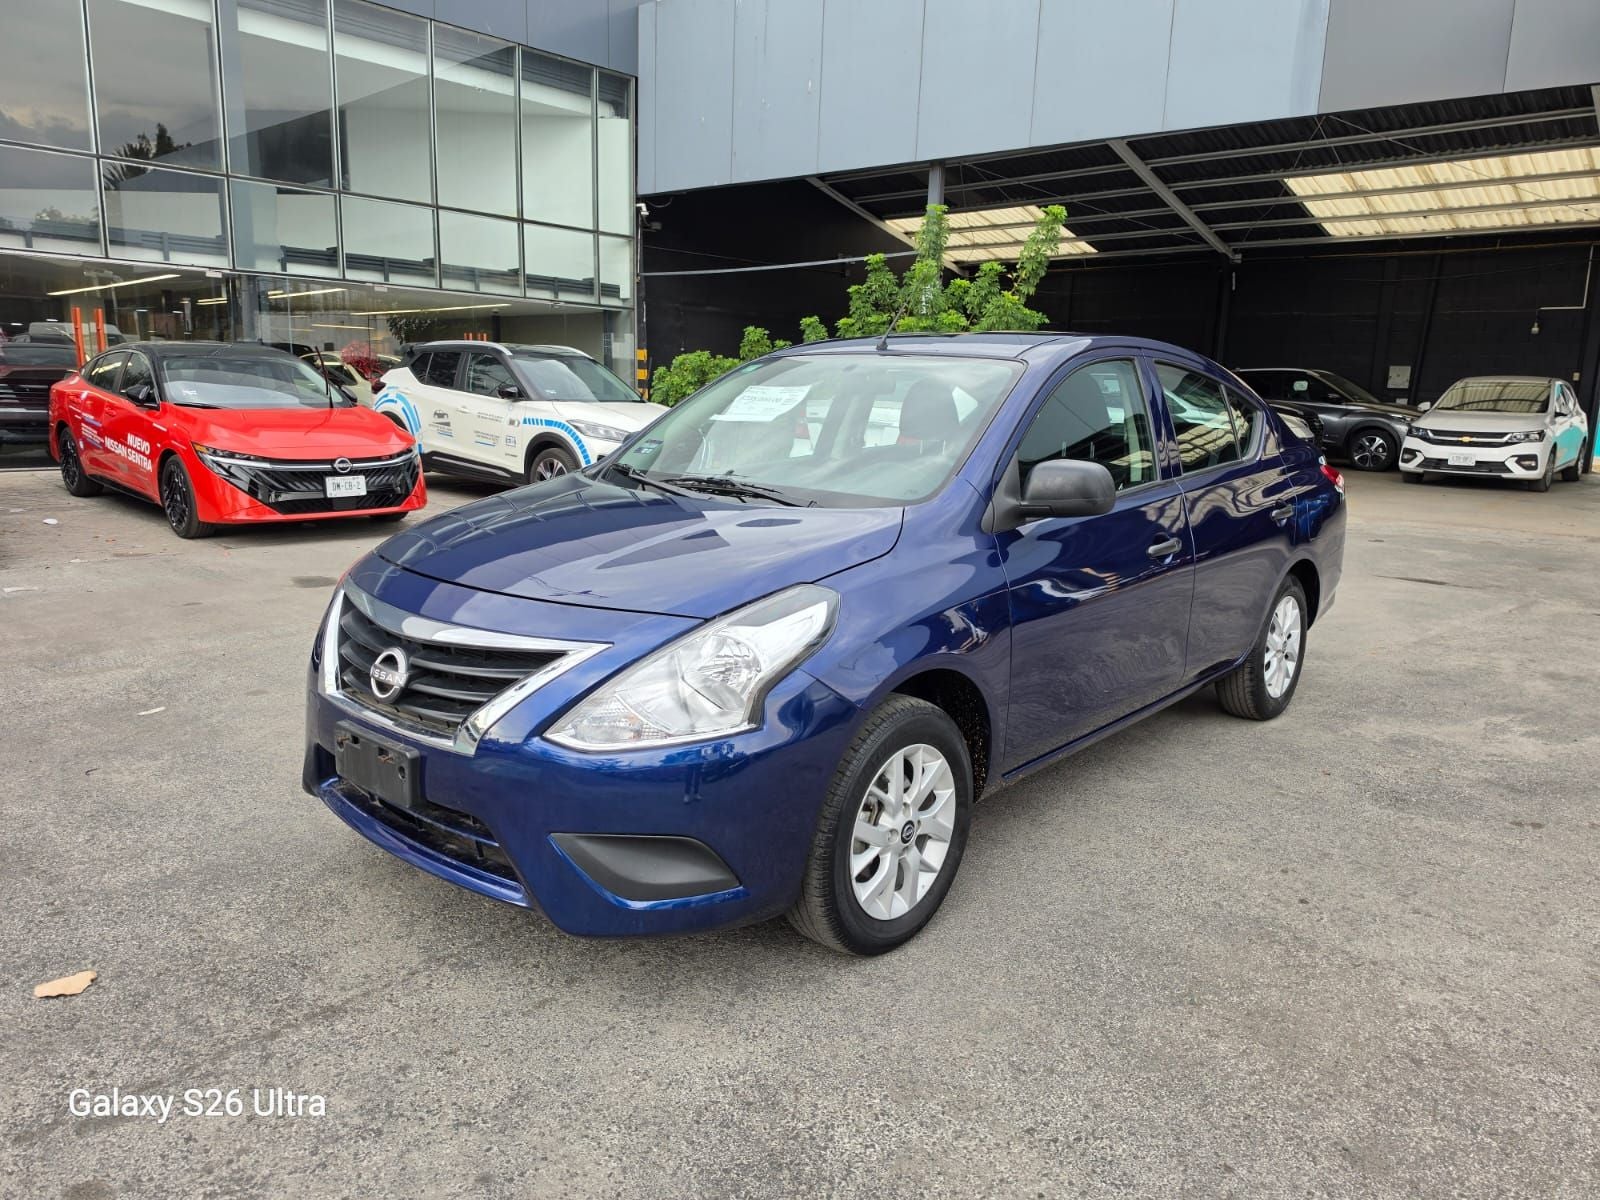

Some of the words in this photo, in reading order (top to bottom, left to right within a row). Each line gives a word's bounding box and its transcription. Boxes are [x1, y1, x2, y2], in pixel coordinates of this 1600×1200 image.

[105, 435, 128, 458] NISSAN
[127, 448, 153, 473] SENTRA
[127, 432, 151, 455] NUEVO
